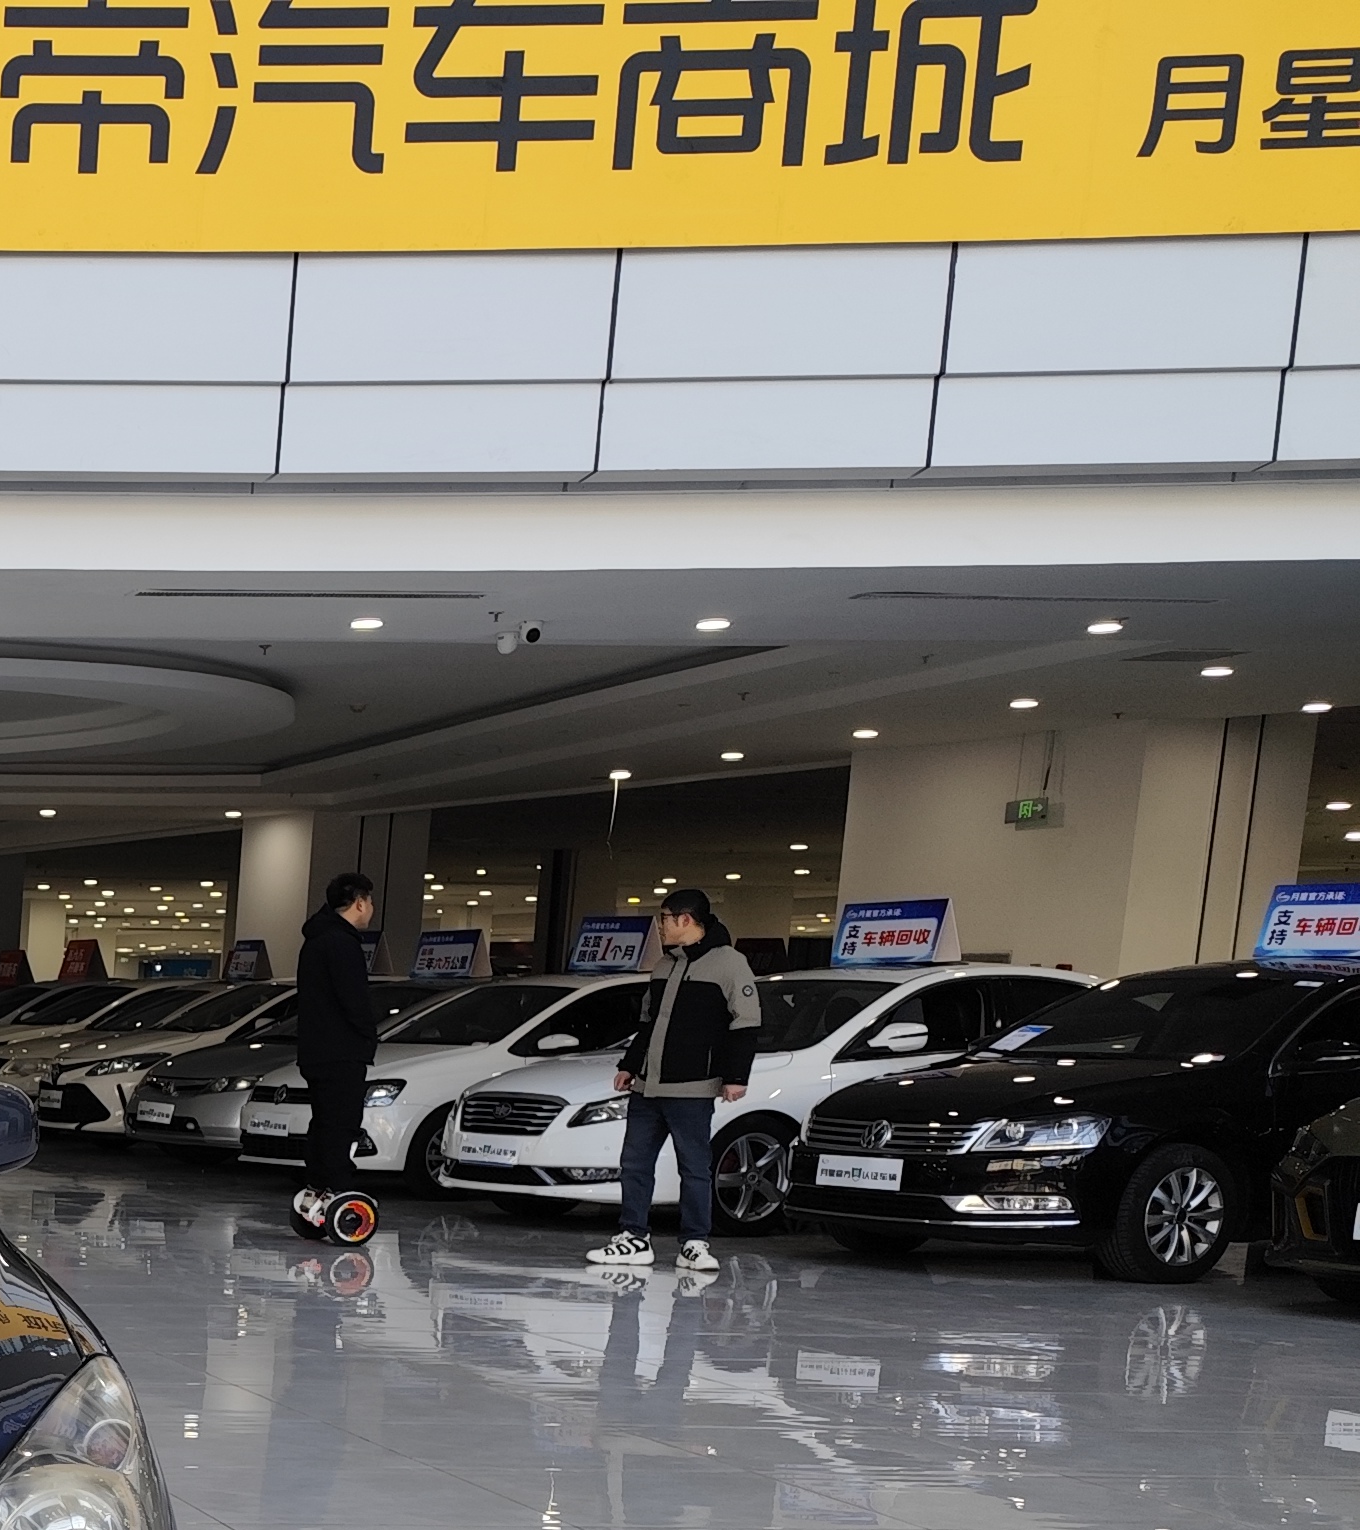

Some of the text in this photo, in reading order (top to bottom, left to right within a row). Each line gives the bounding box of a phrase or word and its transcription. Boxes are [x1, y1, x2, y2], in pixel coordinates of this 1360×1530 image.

[861, 928, 932, 947] 车辆回收
[1266, 910, 1295, 946] 支持
[1293, 917, 1360, 937] 车辆回
[841, 925, 862, 956] 支持
